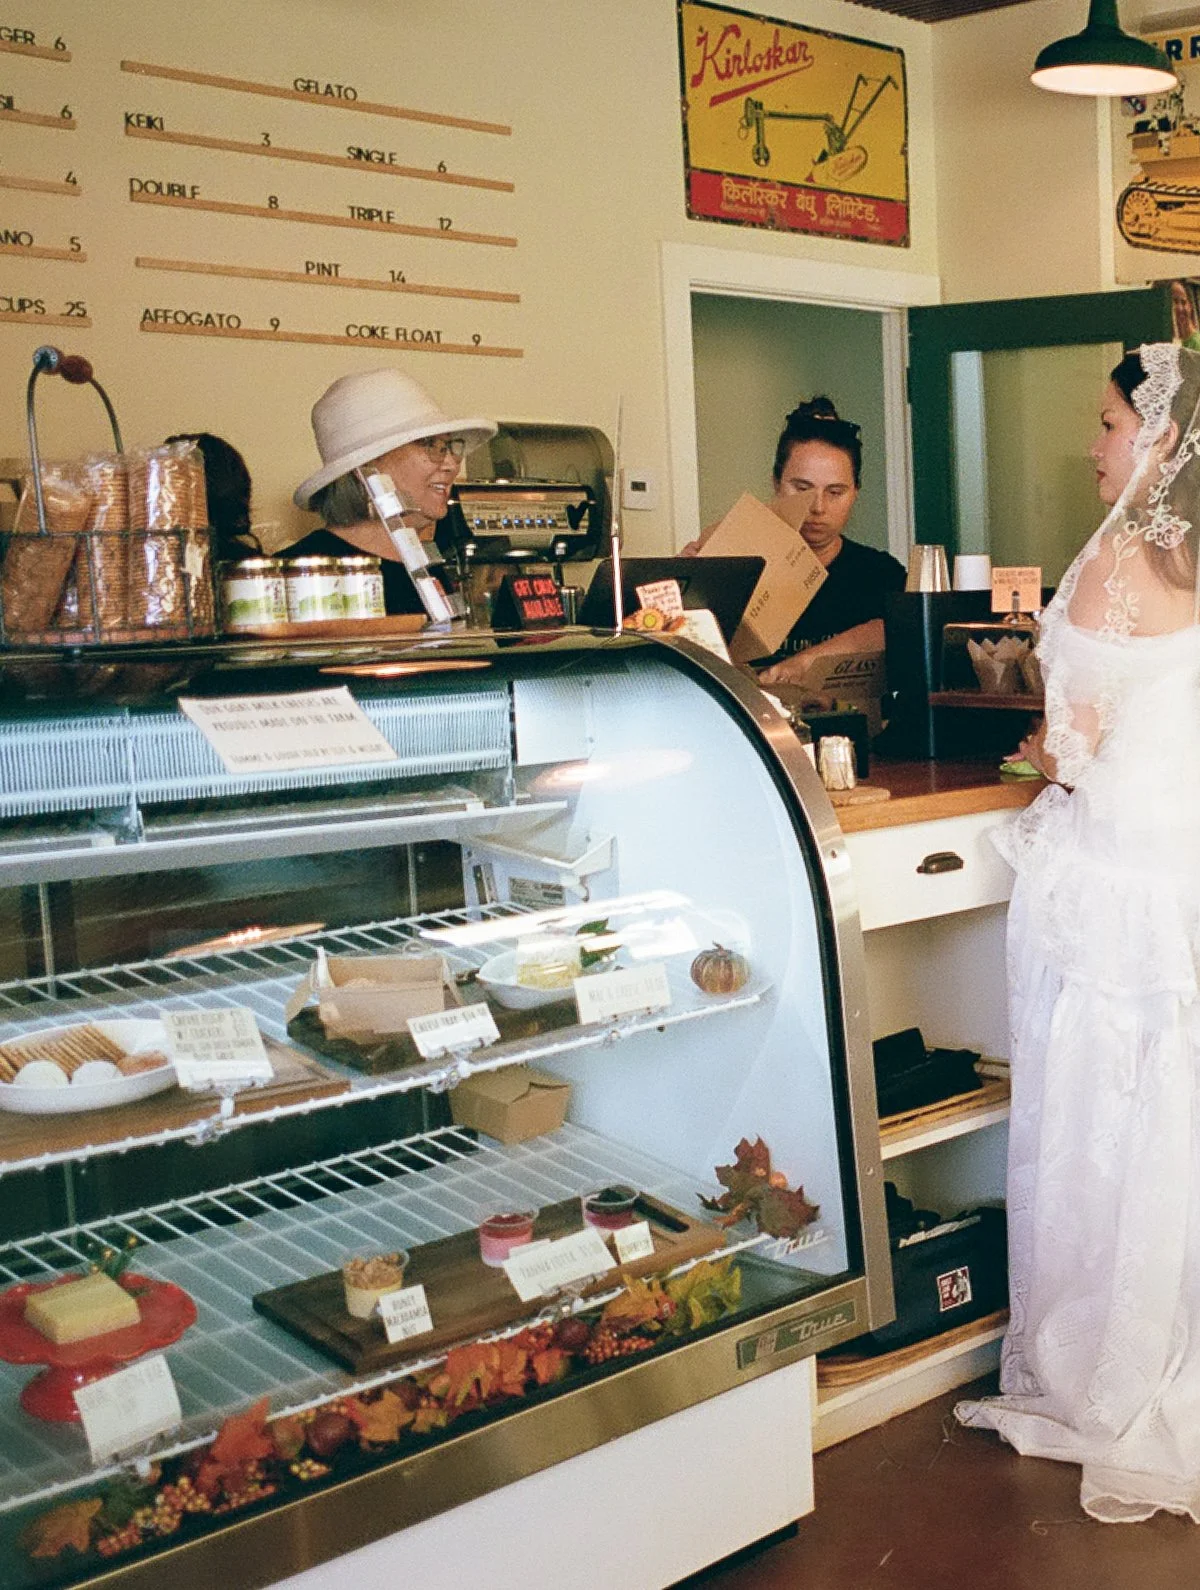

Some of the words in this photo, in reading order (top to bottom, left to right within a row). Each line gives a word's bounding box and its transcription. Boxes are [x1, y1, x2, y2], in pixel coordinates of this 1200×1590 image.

[0, 26, 36, 46] GER
[54, 36, 67, 51] 6
[690, 24, 814, 89] Kirloskar
[293, 77, 358, 101] GELATO
[60, 104, 73, 119] 6
[124, 111, 165, 131] KEIKI
[260, 132, 271, 147] 3
[346, 146, 398, 165] SINGLE
[437, 160, 447, 174] 6
[65, 171, 78, 186] 4
[129, 177, 200, 199] DOUBLE
[268, 195, 280, 210] 8
[349, 205, 396, 224] TRIPLE
[437, 217, 453, 231] 12
[69, 236, 82, 252] 5
[305, 261, 341, 277] PINT
[389, 270, 406, 284] 14
[142, 307, 243, 330] AFFOGATO
[270, 317, 280, 333] 9
[345, 323, 390, 342] COKE
[395, 327, 443, 345] FLOAT
[472, 334, 482, 347] 9
